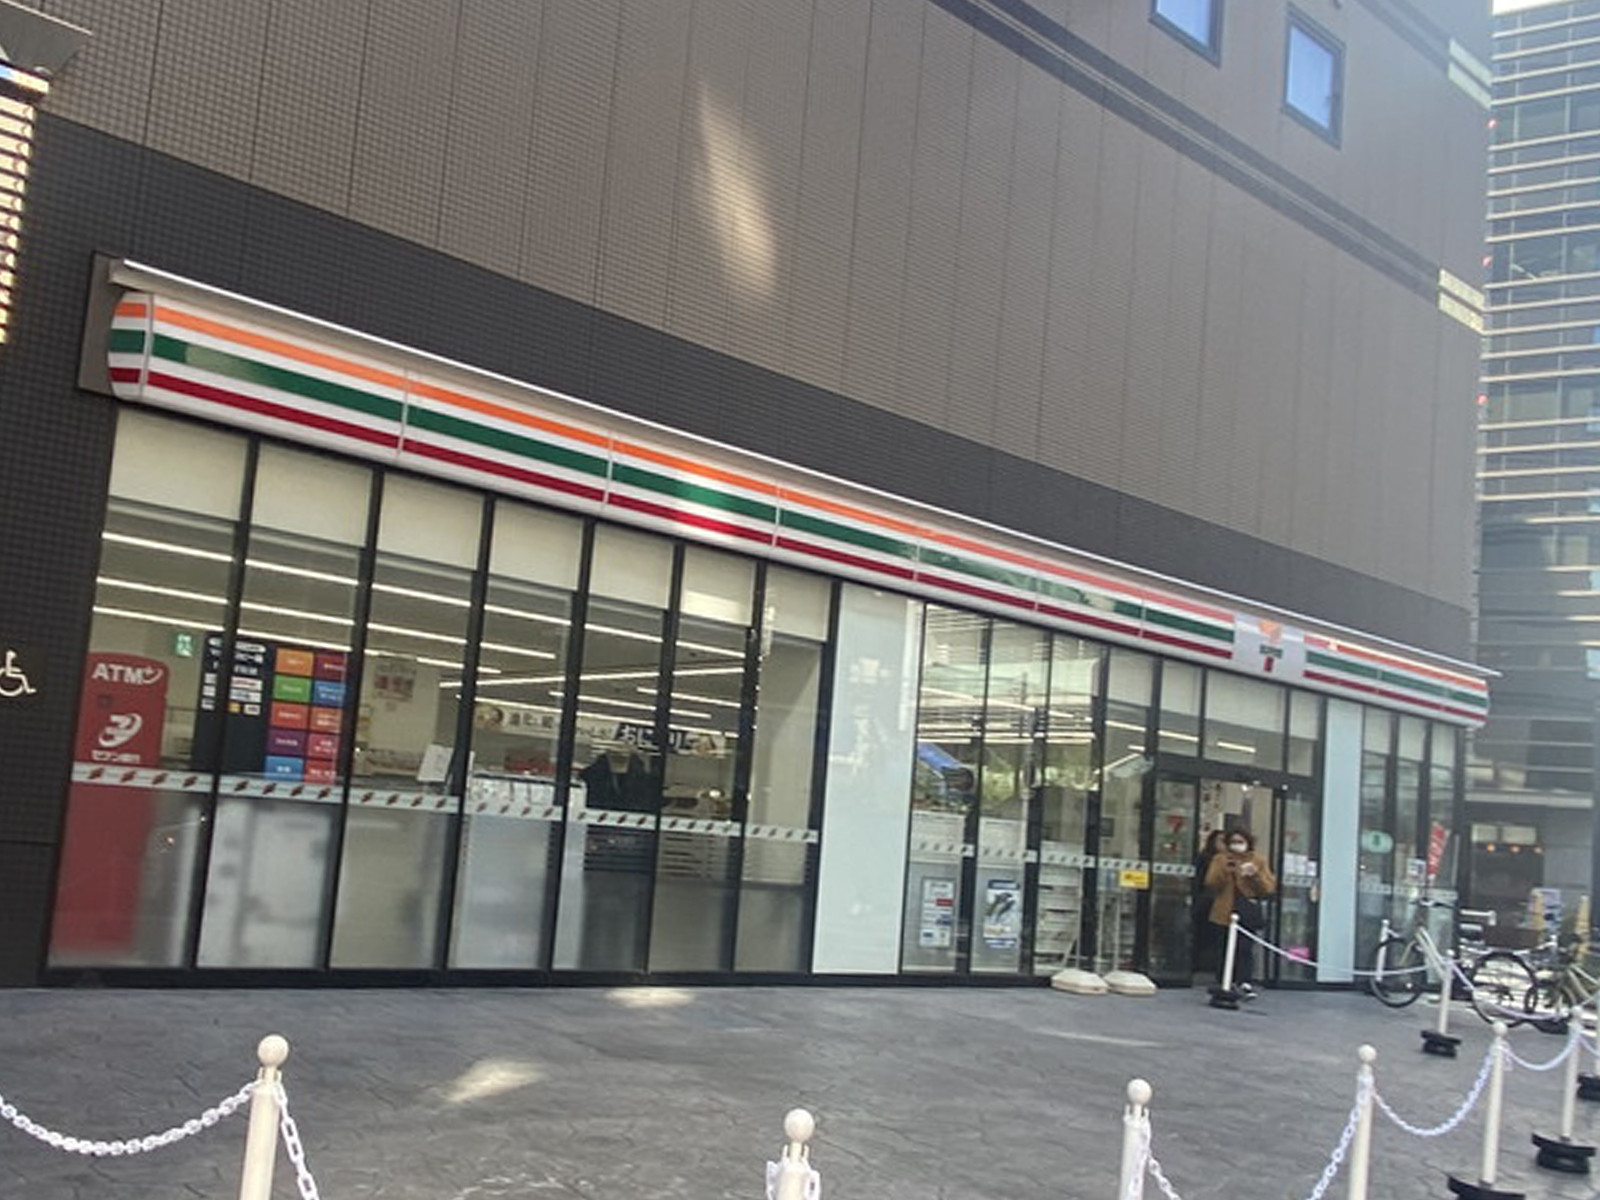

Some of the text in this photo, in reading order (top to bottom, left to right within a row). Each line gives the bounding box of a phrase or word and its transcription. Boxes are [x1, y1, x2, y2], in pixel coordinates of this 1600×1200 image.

[92, 662, 143, 685] ATM
[620, 722, 683, 751] おにり
